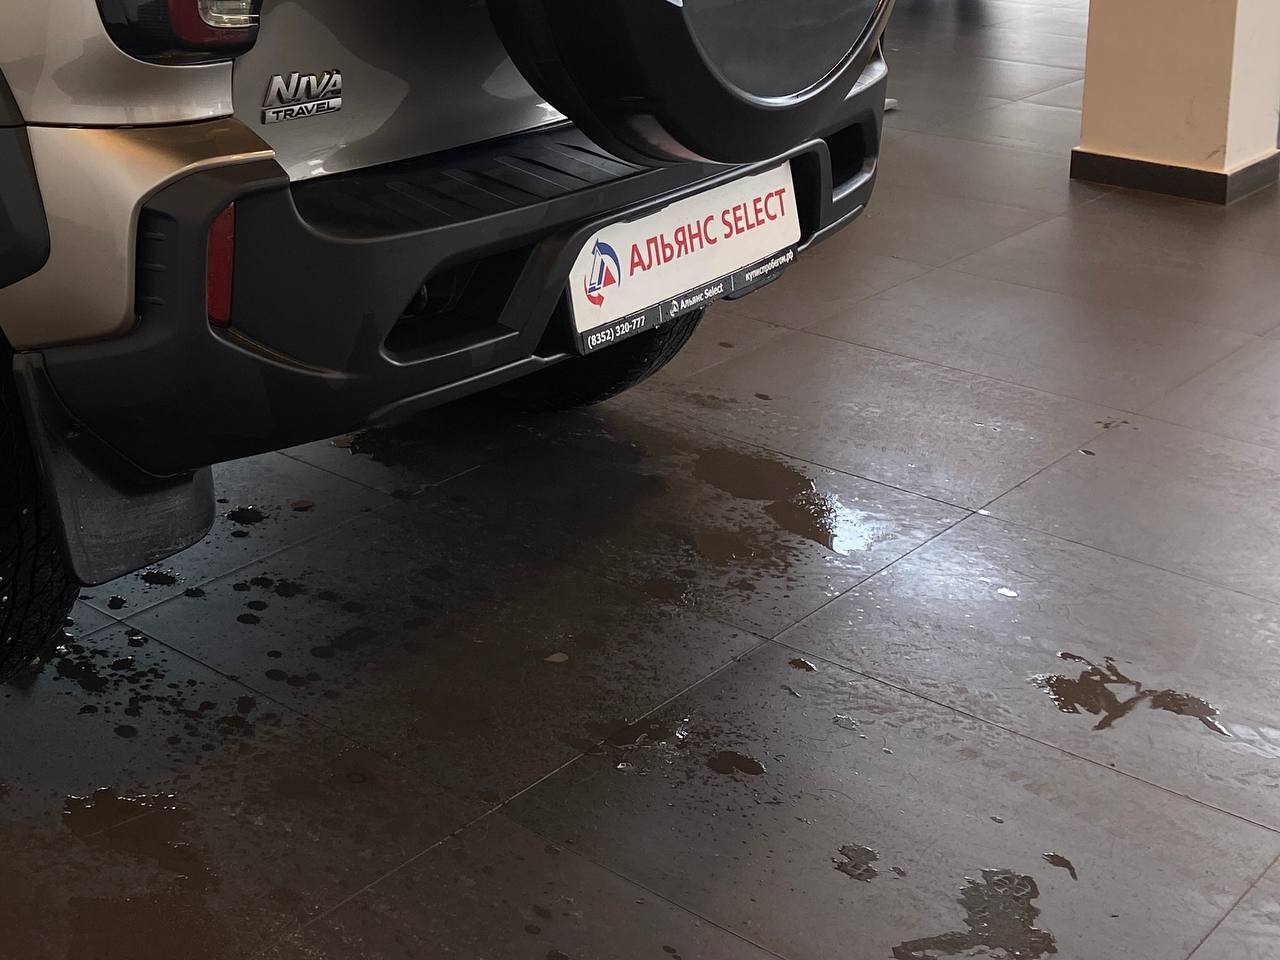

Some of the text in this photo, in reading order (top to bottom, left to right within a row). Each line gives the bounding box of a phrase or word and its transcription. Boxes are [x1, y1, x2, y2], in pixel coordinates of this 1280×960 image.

[263, 69, 342, 107] NIVA
[271, 100, 336, 121] TRAVEL
[628, 188, 786, 277] АЛЬЯНС SELECT
[680, 282, 724, 311] Альянс Select
[587, 315, 646, 350] (8352) 320-777
